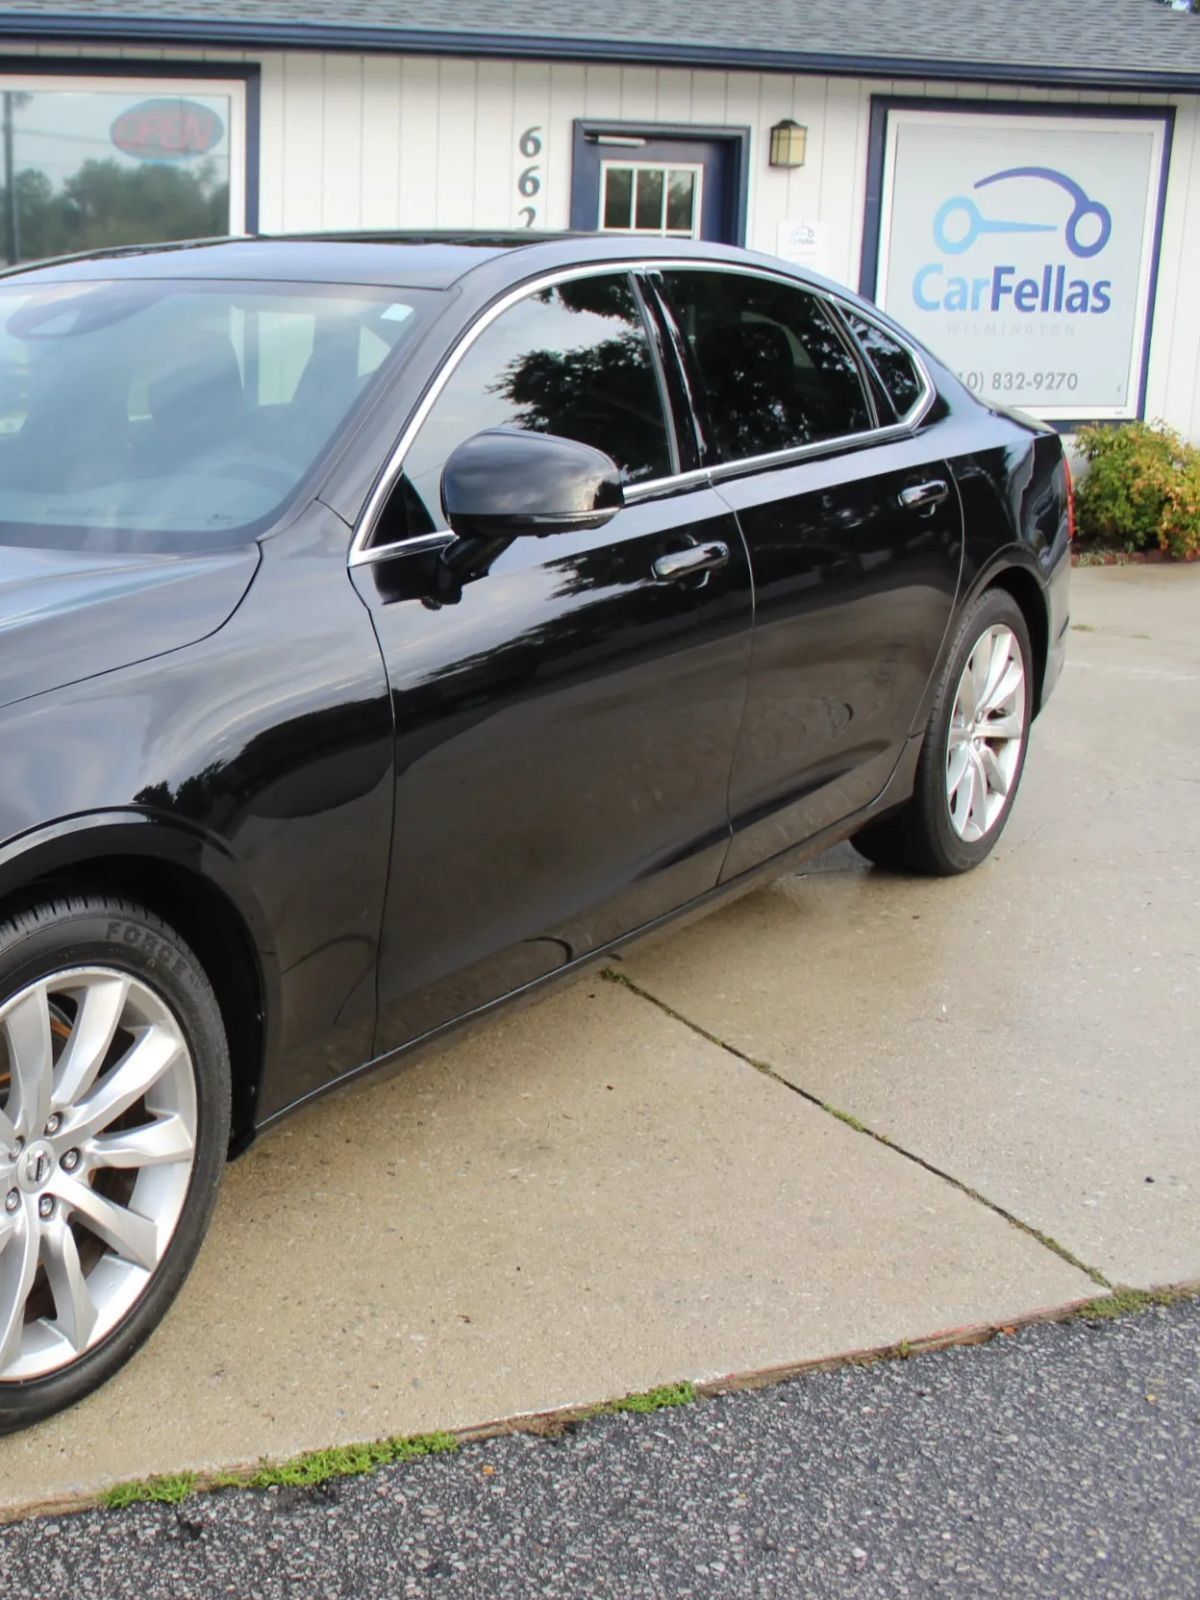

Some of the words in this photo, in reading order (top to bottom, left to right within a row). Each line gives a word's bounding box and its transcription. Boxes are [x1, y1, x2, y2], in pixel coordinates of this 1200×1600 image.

[912, 263, 1111, 314] CarFellas
[946, 322, 1076, 336] WILMINGTON
[992, 372, 1078, 390] 832-9270
